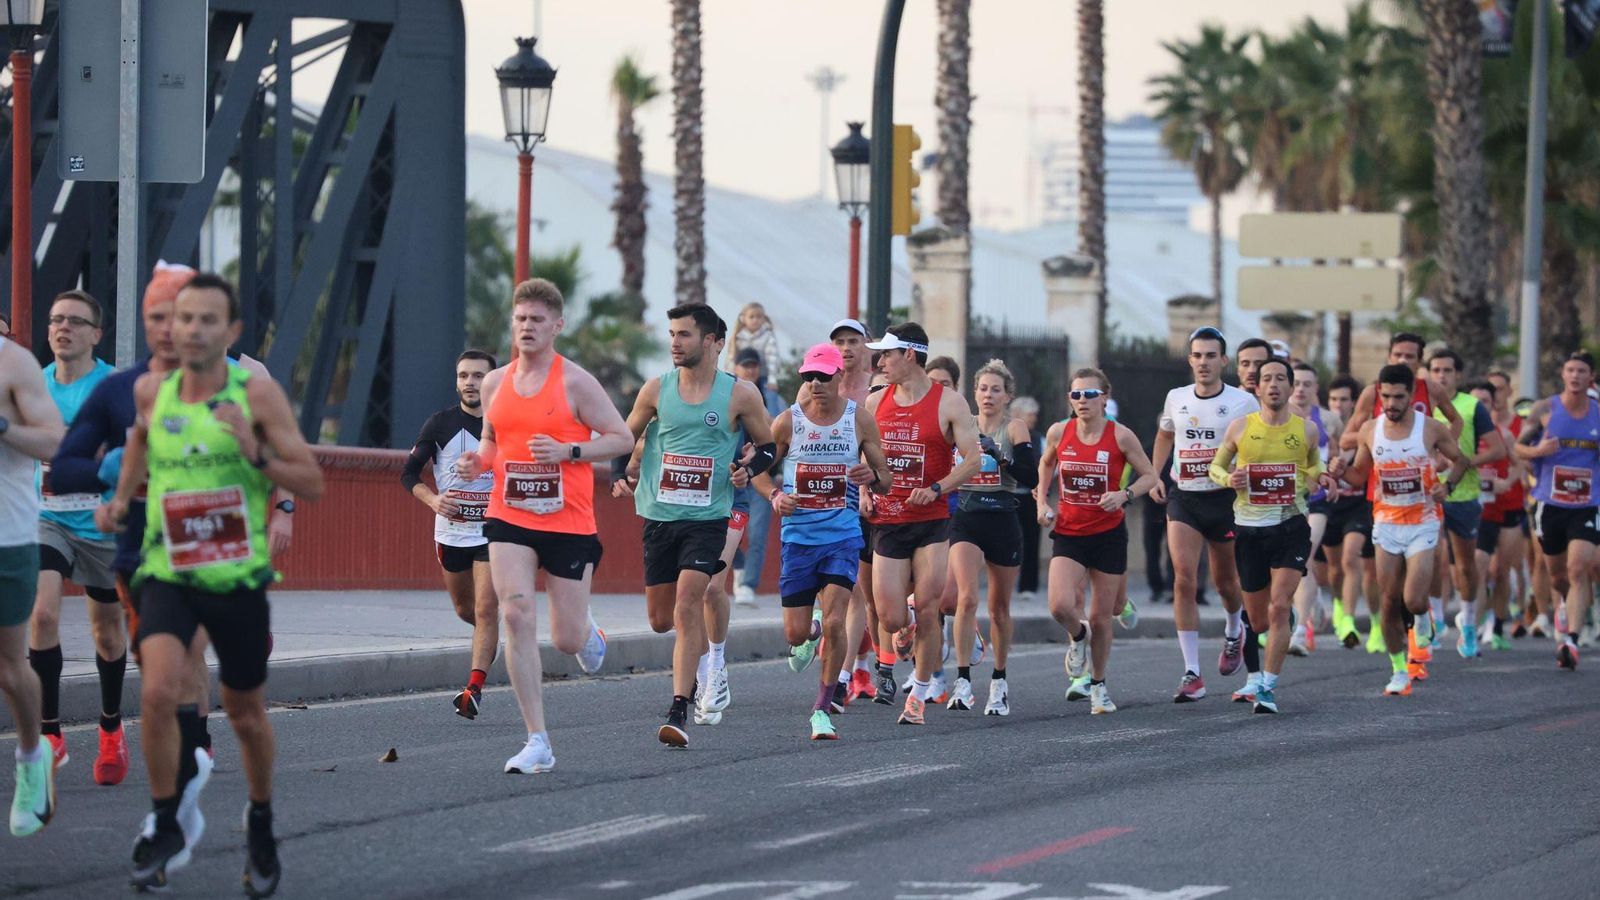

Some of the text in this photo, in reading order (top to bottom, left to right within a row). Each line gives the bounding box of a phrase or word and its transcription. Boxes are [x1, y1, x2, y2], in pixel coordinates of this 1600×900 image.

[1186, 429, 1215, 439] SYB
[799, 443, 850, 453] MARACENA
[888, 444, 921, 453] GENERALI
[673, 457, 710, 467] GENERALI
[887, 457, 911, 468] 5407
[518, 464, 556, 473] GENERALI
[808, 465, 843, 473] GENERALI
[1073, 464, 1104, 473] GENERALI
[1261, 465, 1293, 473] GENERALI
[669, 471, 701, 484] 17672
[1072, 477, 1095, 487] 7865
[1261, 478, 1284, 487] 4393
[516, 481, 549, 492] 10973
[808, 480, 834, 489] 6168
[458, 506, 487, 516] 12527
